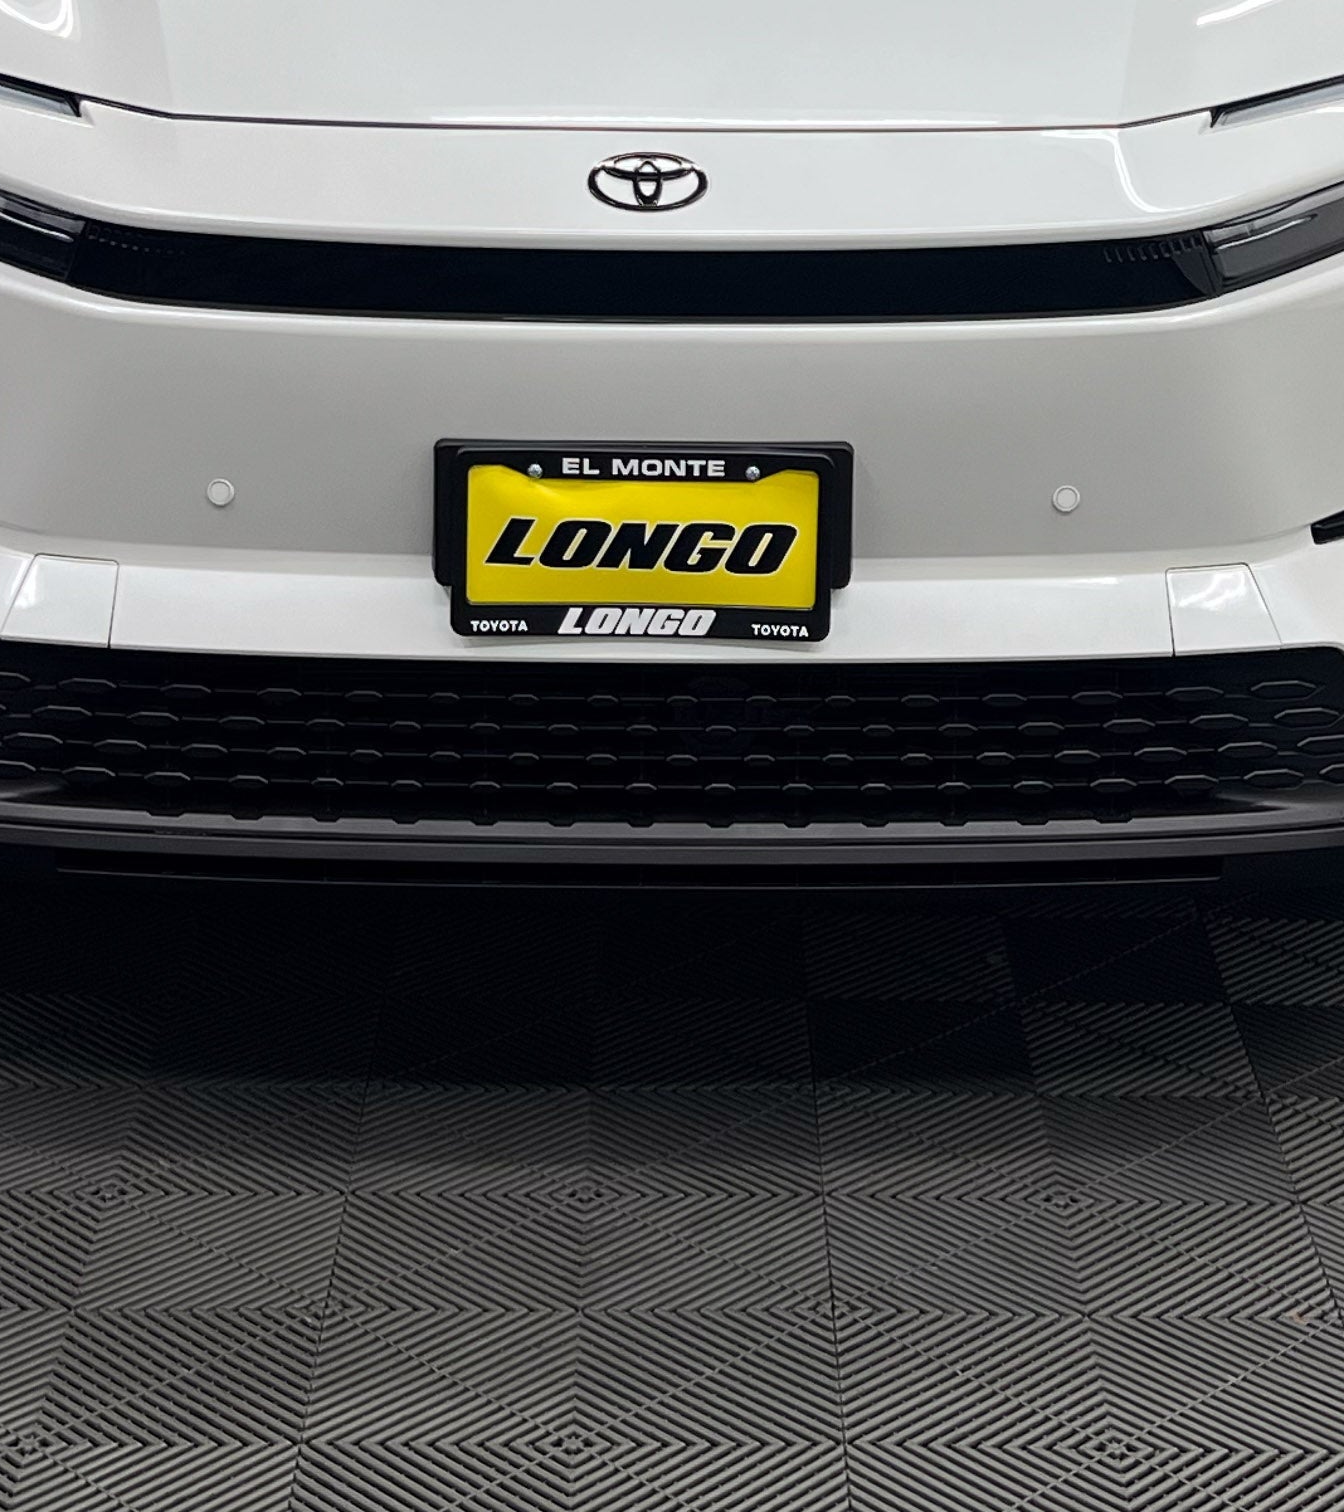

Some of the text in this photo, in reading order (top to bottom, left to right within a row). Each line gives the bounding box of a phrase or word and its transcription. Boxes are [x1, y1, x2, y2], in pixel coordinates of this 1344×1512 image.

[561, 457, 727, 478] EL MONTE
[483, 517, 799, 576] LONGO
[469, 619, 529, 634] TOYOTA
[557, 607, 717, 637] LONGO
[751, 623, 809, 639] TOYOTA
